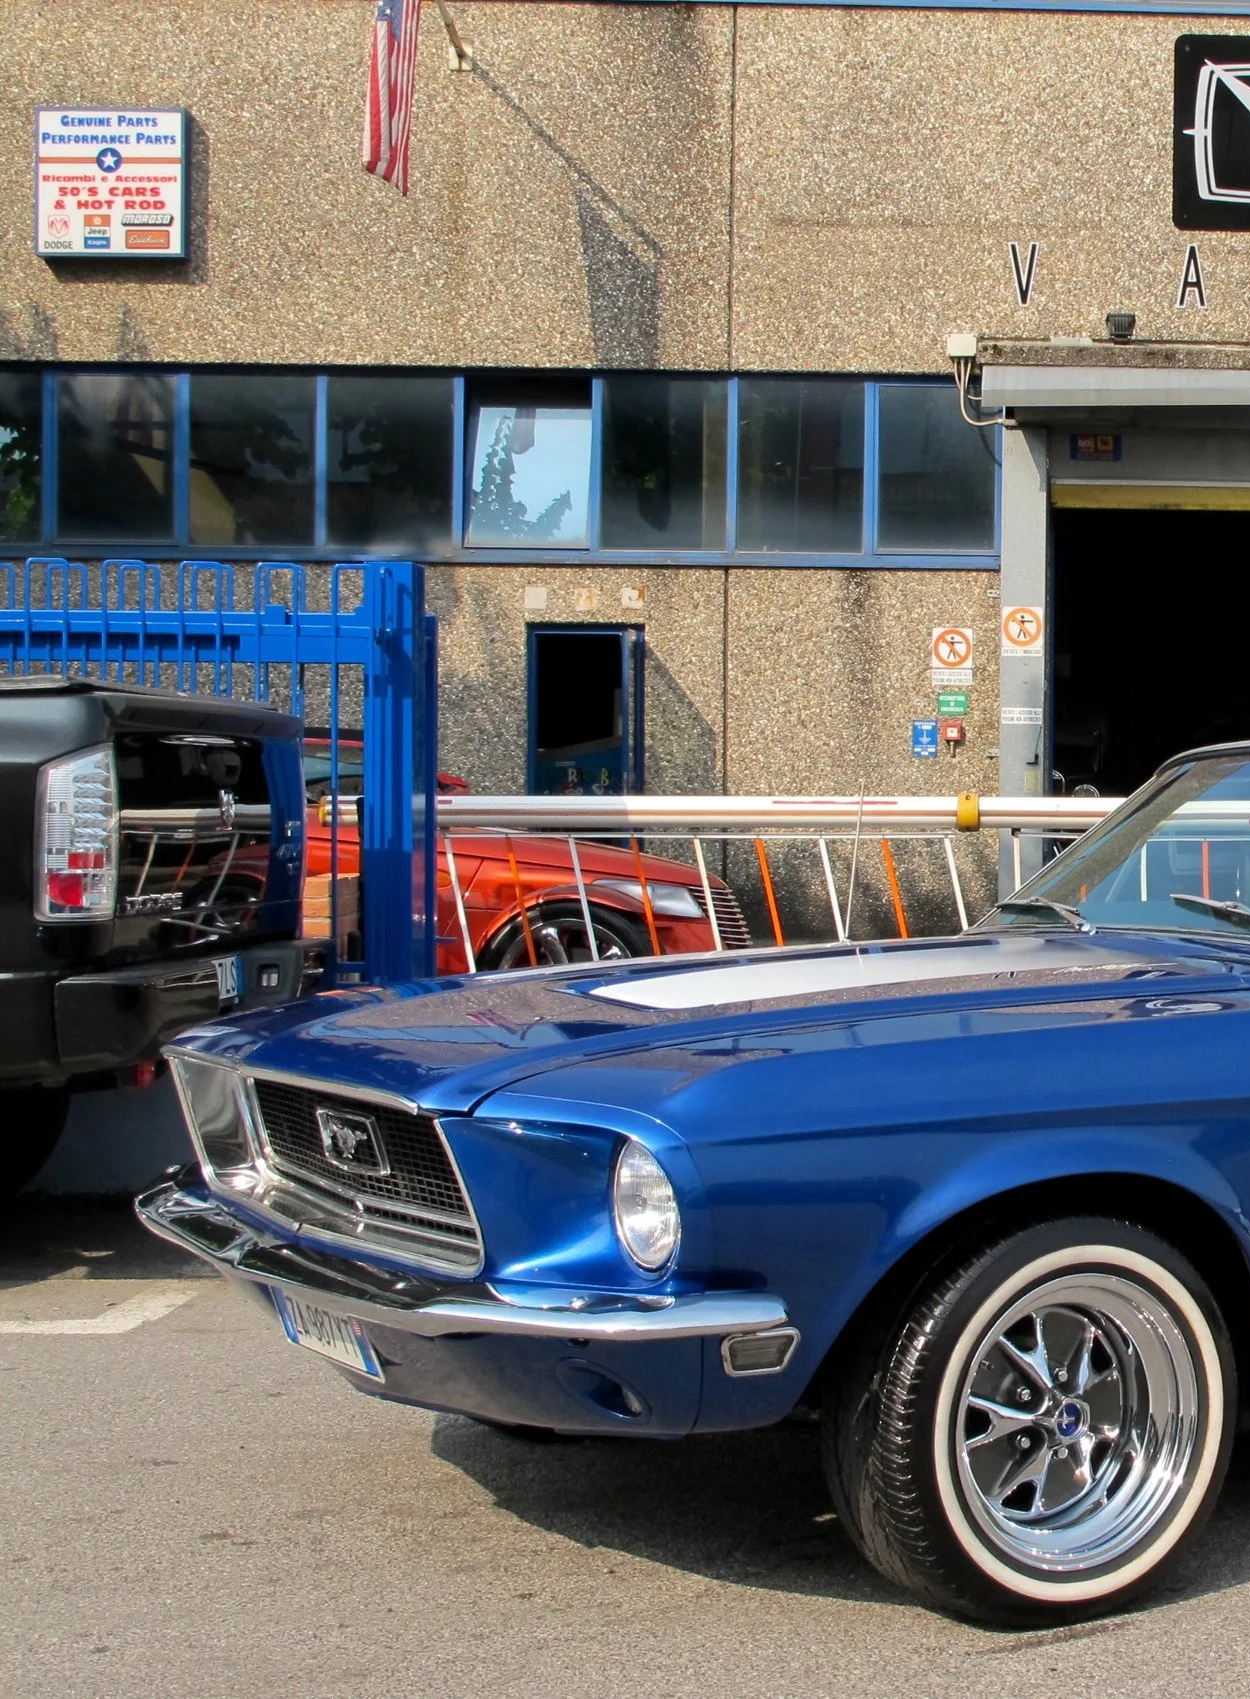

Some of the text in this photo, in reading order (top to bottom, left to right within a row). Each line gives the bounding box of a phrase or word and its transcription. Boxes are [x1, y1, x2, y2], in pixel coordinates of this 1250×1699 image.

[115, 175, 177, 183] Accessori
[108, 187, 161, 197] CARS
[54, 200, 166, 210] & HOT ROD
[87, 228, 108, 236] Jeep
[44, 241, 73, 249] DODGE
